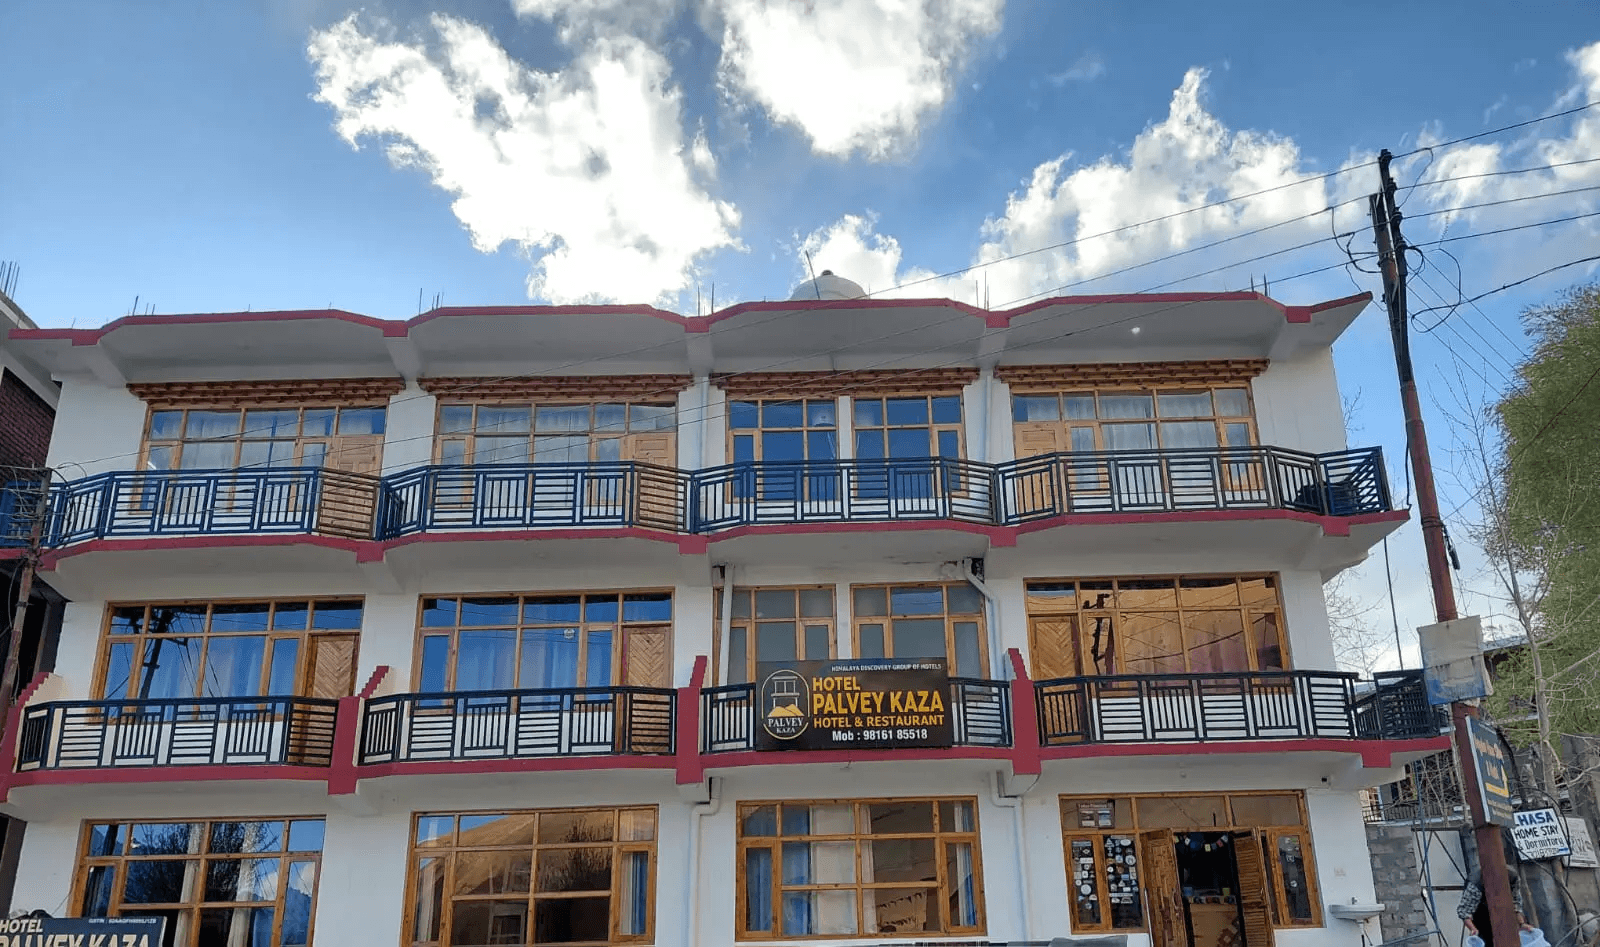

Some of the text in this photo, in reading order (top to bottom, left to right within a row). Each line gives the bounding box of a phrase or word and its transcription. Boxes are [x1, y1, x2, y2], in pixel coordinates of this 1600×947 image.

[892, 663, 912, 671] GROUP
[812, 676, 861, 691] HOTEL
[813, 690, 944, 715] PALVEY KAZA
[768, 717, 803, 727] PALVEY
[813, 714, 945, 729] HOTEL & RESTAURANT
[832, 730, 854, 741] Mob
[863, 729, 893, 741] 98161
[896, 728, 928, 740] 85518
[1514, 811, 1554, 826] HASA
[1514, 826, 1539, 840] HOME
[1540, 825, 1559, 836] STAY
[0, 919, 43, 933] HOTEL
